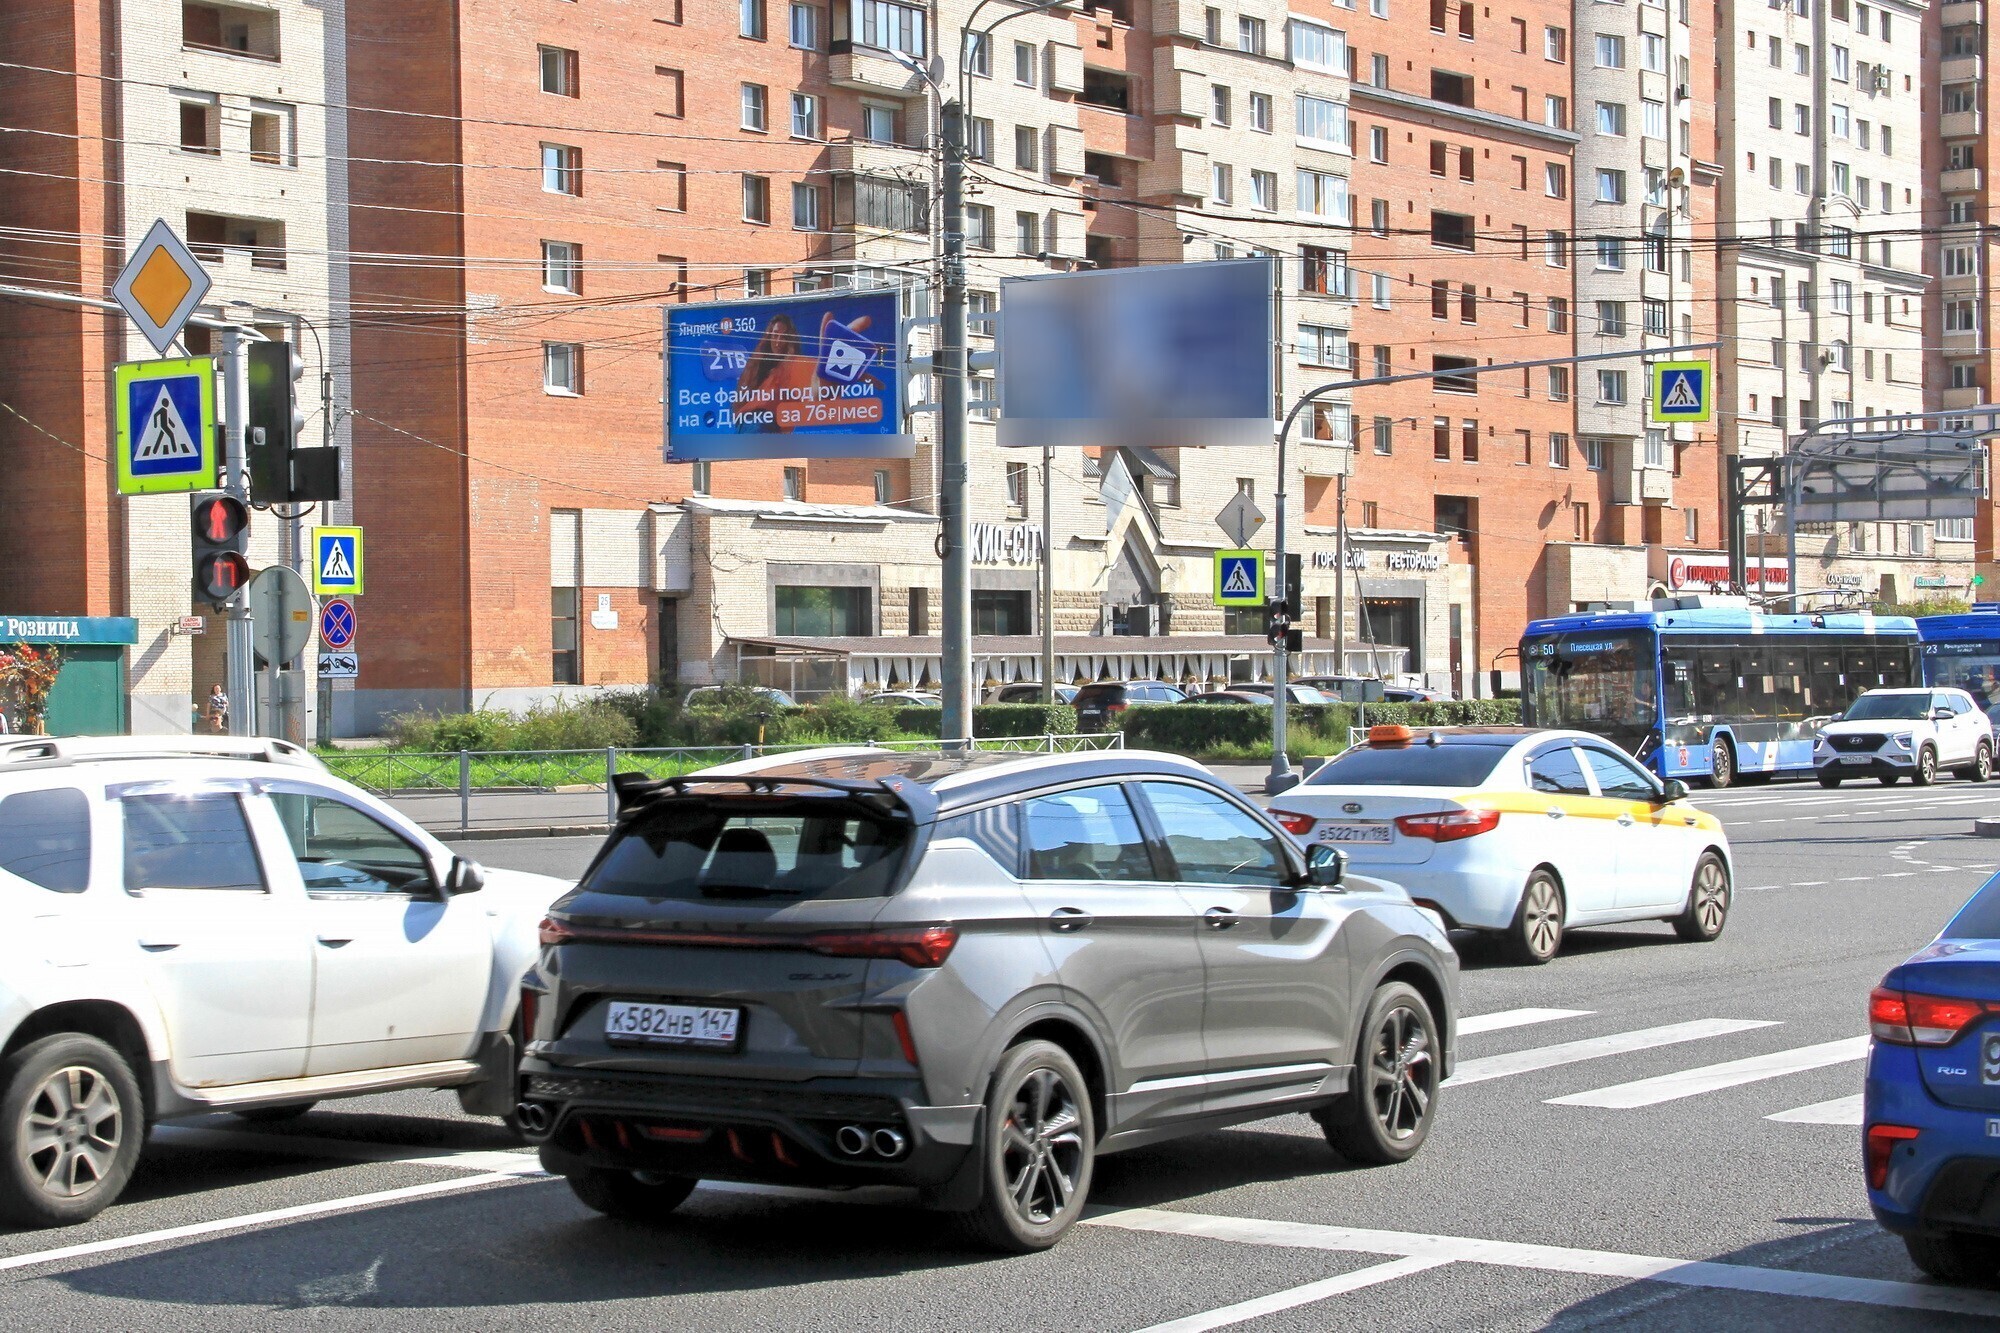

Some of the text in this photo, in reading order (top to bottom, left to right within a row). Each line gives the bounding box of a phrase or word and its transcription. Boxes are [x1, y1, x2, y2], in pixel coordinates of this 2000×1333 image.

[679, 317, 756, 337] Яндекс 360
[679, 379, 874, 406] Все файлы под рукой
[679, 413, 699, 427] на
[716, 409, 773, 426] Диске
[781, 410, 801, 423] за
[1315, 551, 1440, 570] ГОРОСКИЕ РЕСТОРАНЫ
[600, 596, 608, 606] 25
[1543, 642, 1614, 655] 50 Плесецкая ул.
[1926, 644, 1938, 654] 23
[611, 1006, 733, 1035] К582НВ 147
